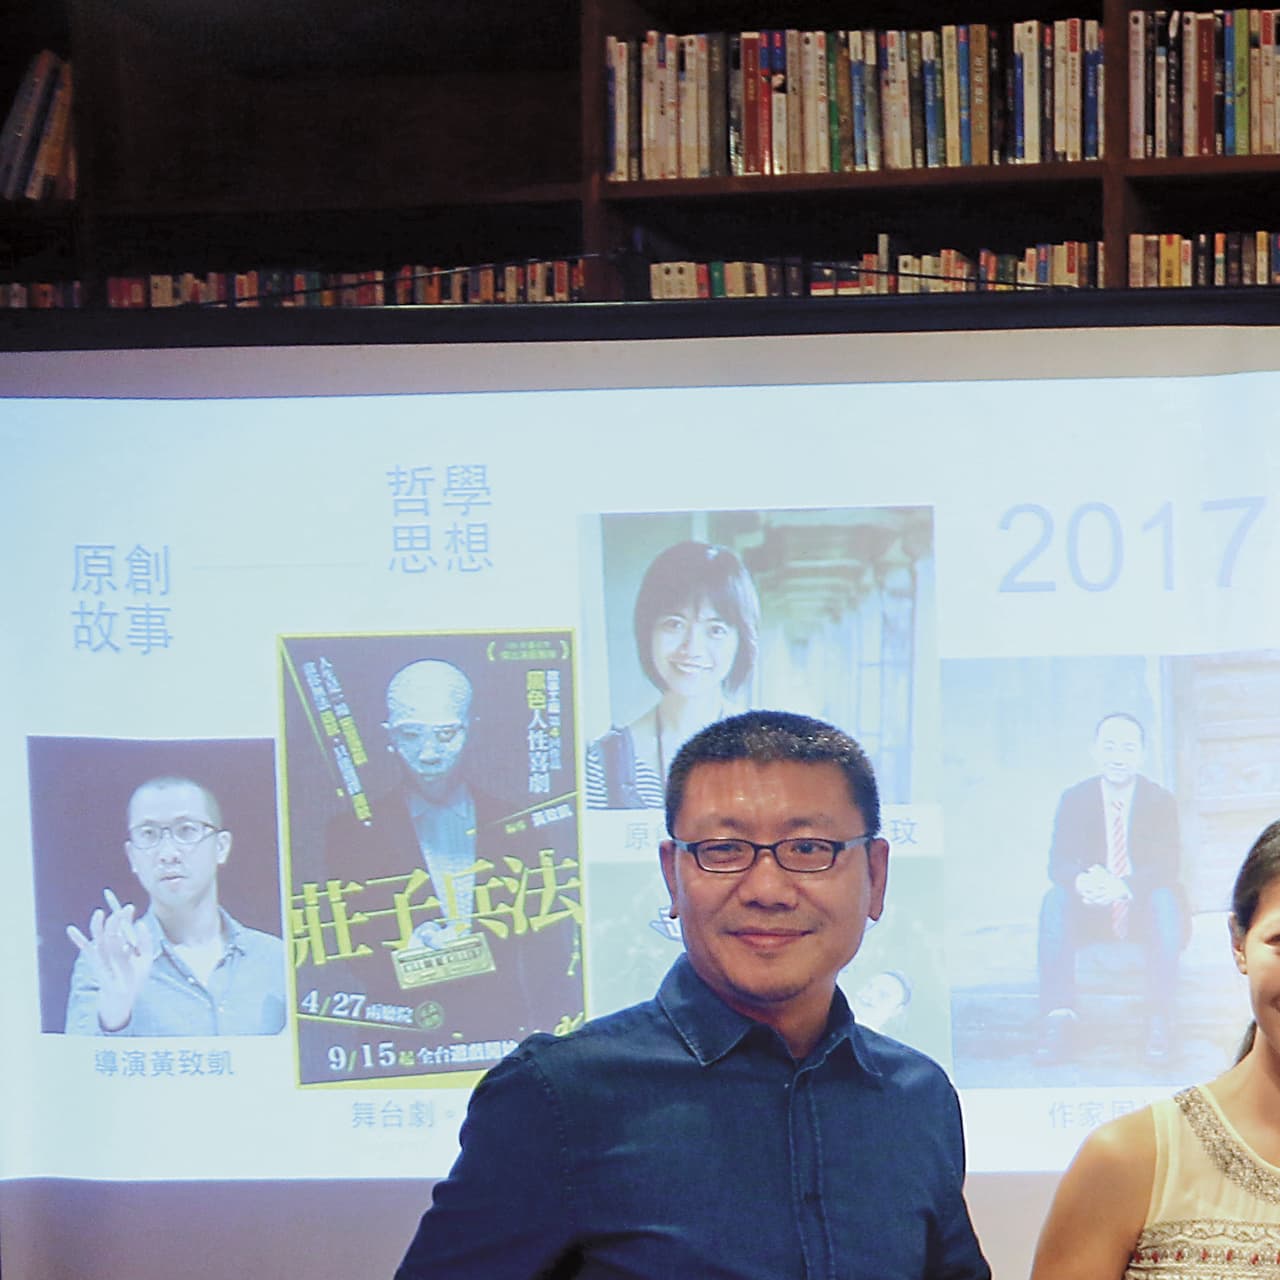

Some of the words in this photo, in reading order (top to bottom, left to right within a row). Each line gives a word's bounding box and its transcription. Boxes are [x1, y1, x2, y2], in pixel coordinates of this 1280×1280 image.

[385, 463, 493, 518] 哲學
[71, 543, 171, 596] 原創
[387, 521, 495, 574] 思想
[998, 495, 1267, 593] 2017
[71, 600, 175, 655] 故事
[289, 848, 584, 968] 莊子兵法
[301, 989, 367, 1018] 4/27
[95, 1048, 236, 1078] 導演黃致凱
